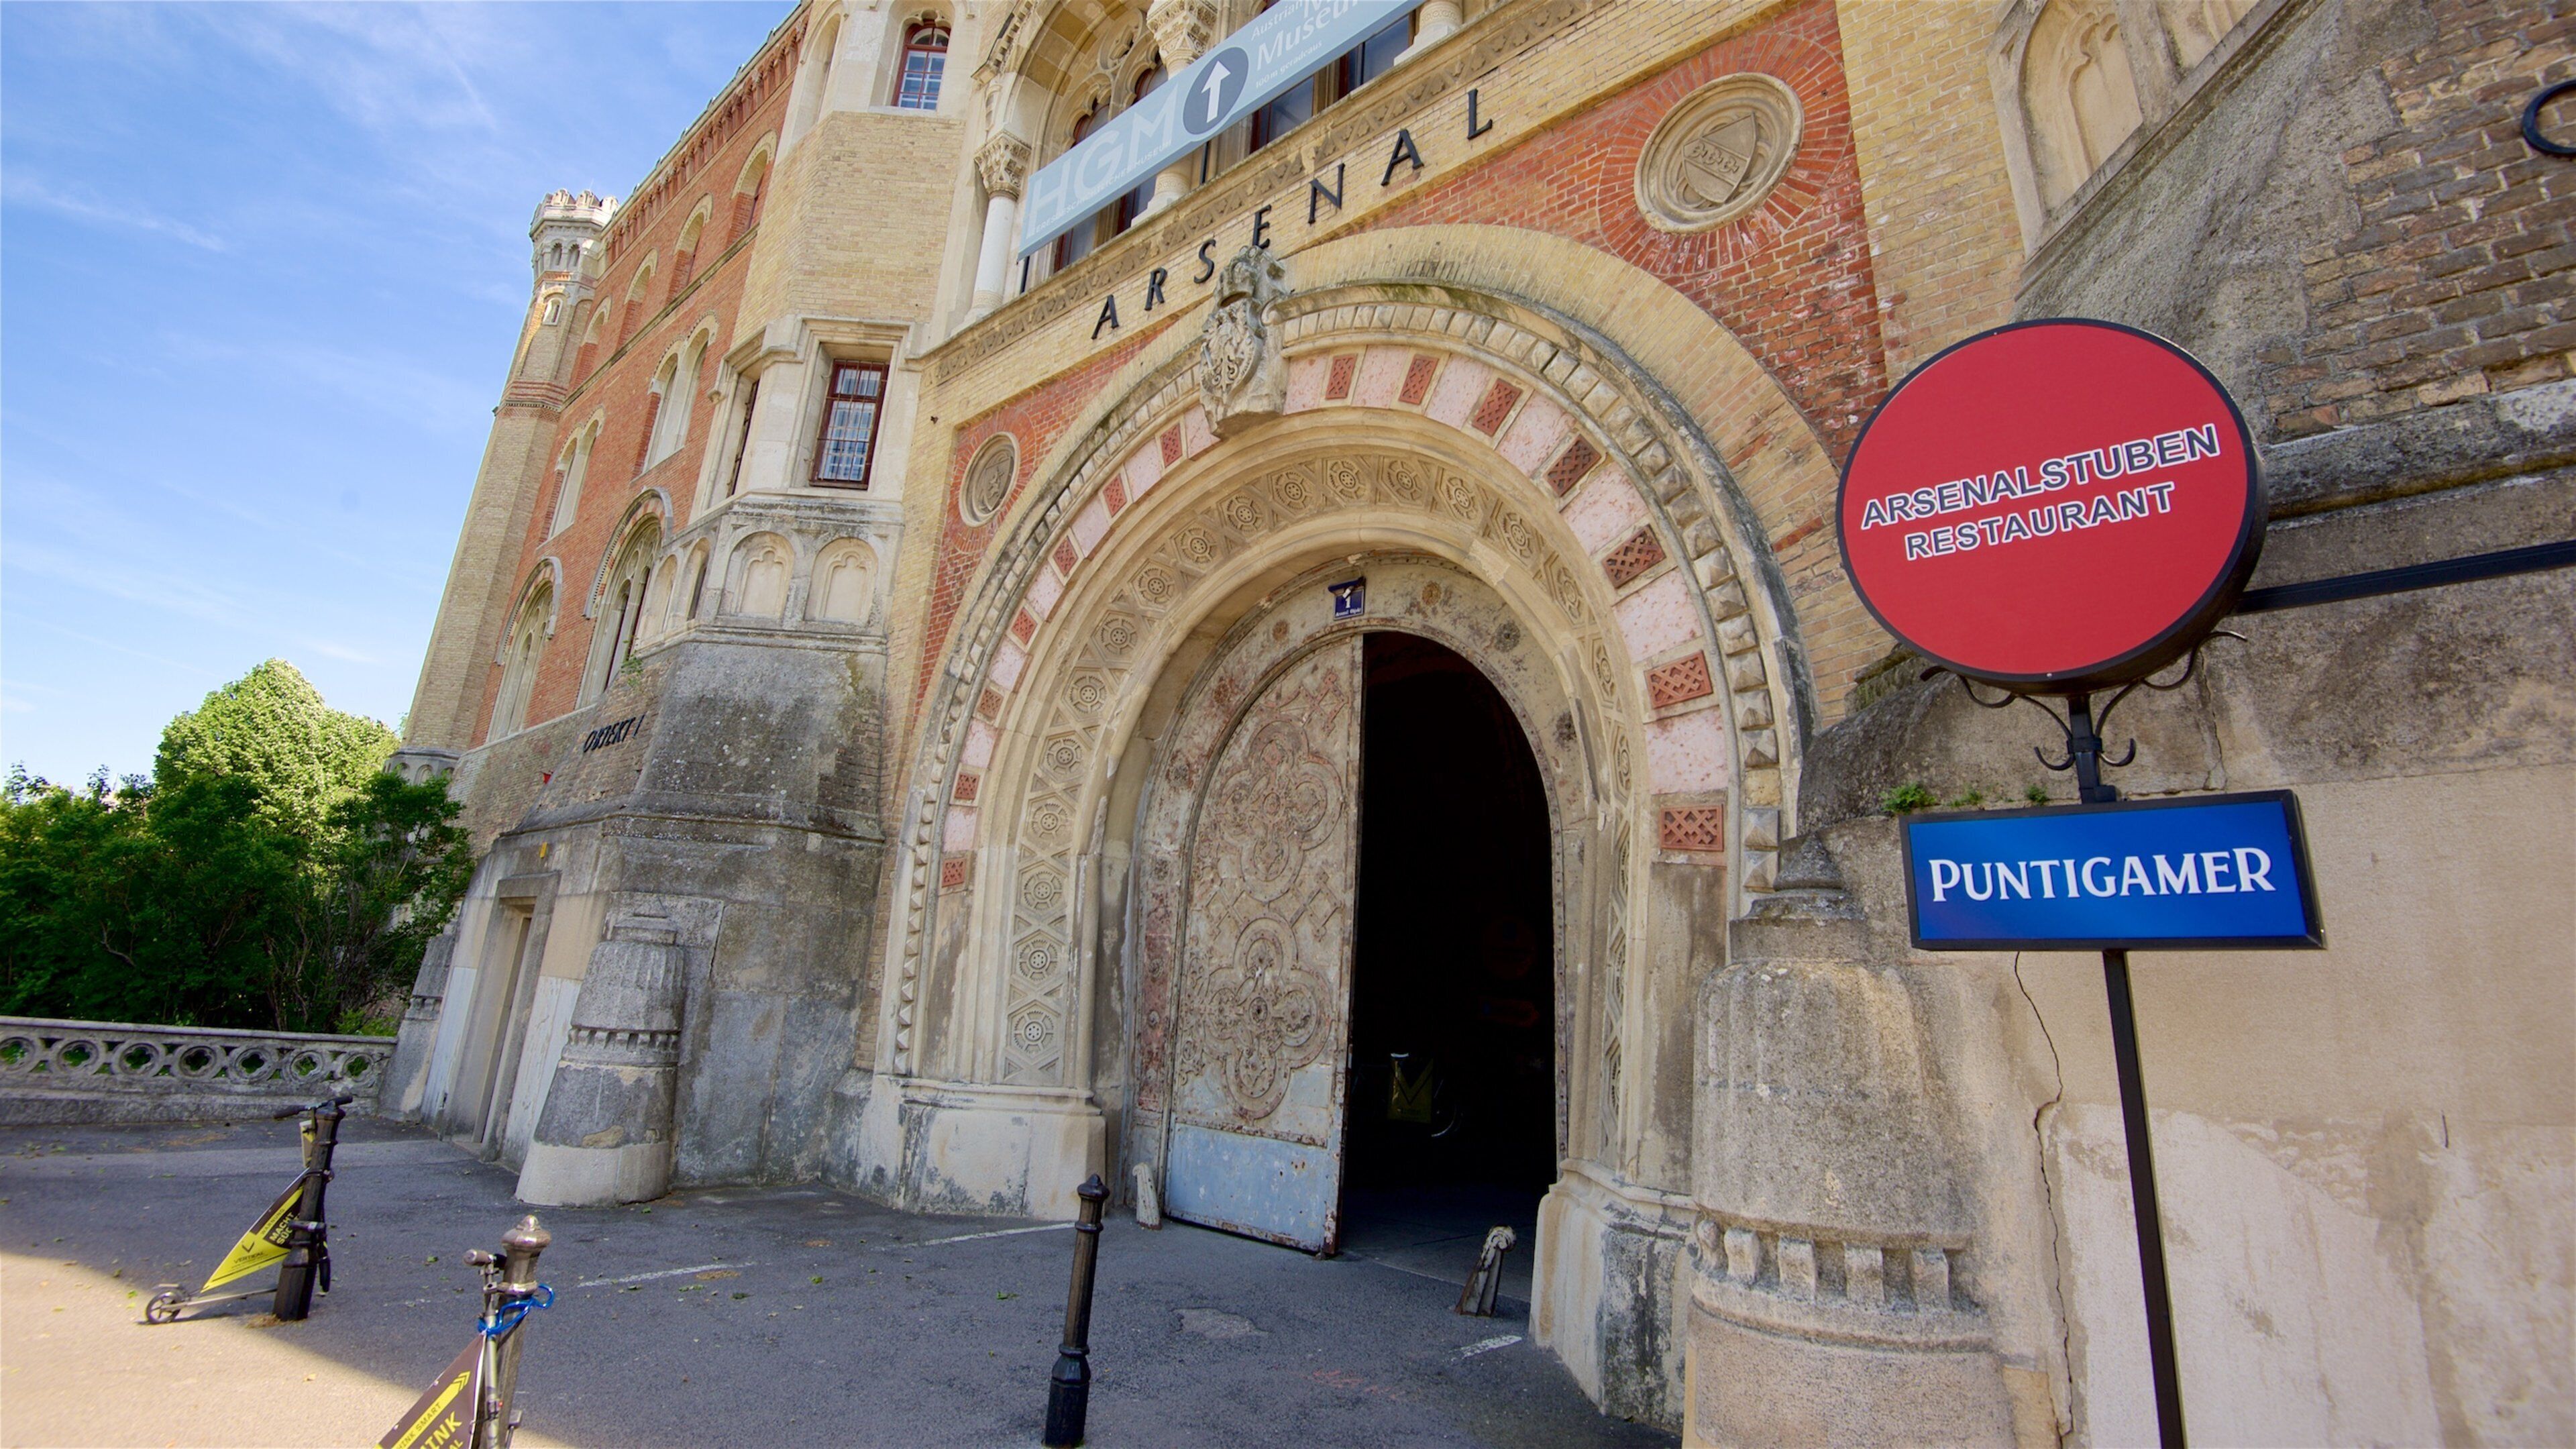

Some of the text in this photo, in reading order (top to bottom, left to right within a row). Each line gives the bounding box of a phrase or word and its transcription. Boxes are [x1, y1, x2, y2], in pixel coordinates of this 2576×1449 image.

[1256, 0, 1358, 70] Museu
[1090, 89, 1493, 341] ARSENAL
[1861, 423, 2220, 531] ARSENALSTUBEN
[1905, 482, 2175, 561] RESTAURANT
[1928, 847, 2277, 903] PUNTIGAMER
[269, 1212, 294, 1241] MACHT
[415, 1403, 441, 1432] SMART
